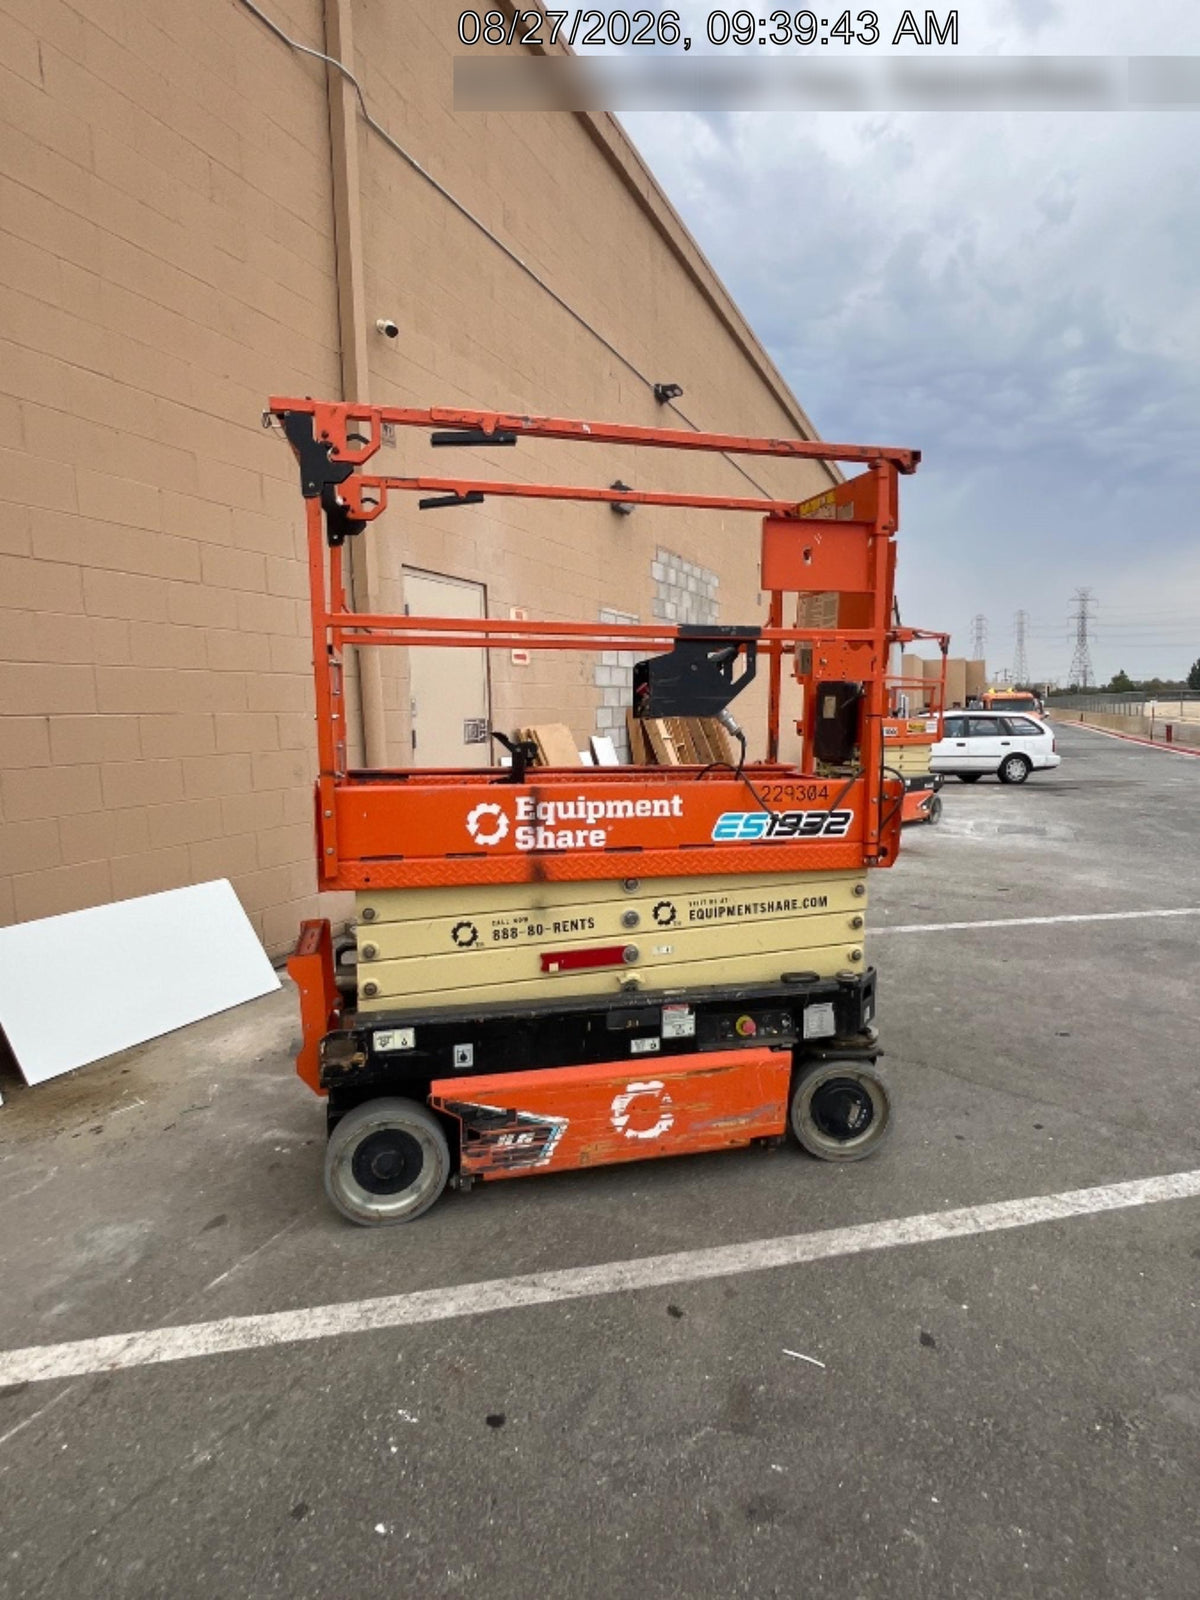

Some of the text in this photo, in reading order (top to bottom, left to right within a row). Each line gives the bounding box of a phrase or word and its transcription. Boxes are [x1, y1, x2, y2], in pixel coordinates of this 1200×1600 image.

[761, 785, 830, 803] 229304
[515, 795, 684, 825] Equipment
[712, 810, 854, 841] ES1932
[515, 826, 607, 850] Share
[688, 896, 828, 921] EQUIPMENTSHARE.COM
[492, 918, 595, 941] 888-80-RENTS
